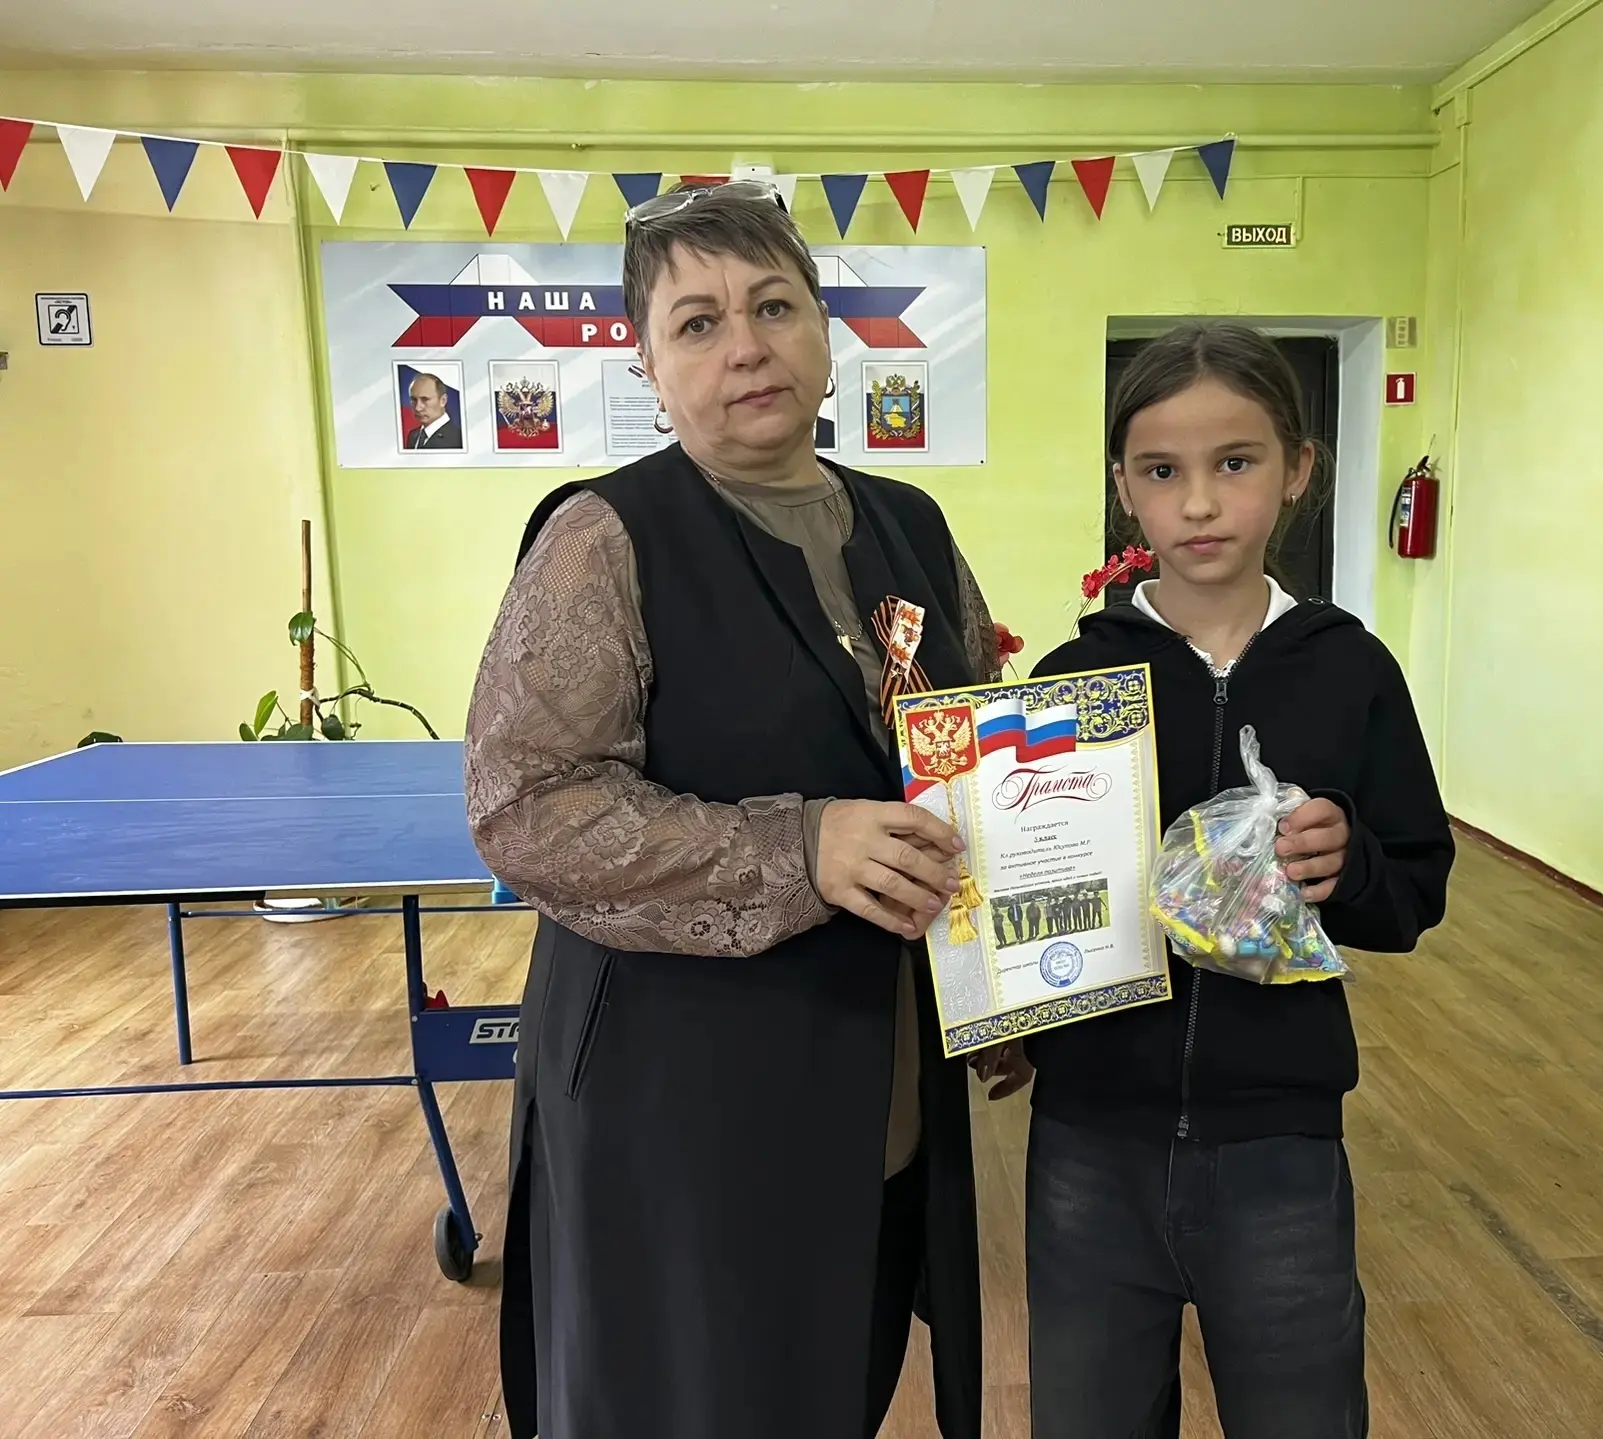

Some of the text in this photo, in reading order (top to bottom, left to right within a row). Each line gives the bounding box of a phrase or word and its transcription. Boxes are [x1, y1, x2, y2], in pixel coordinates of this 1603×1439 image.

[1231, 227, 1287, 244] ВЫХОД
[487, 291, 596, 311] НАША
[581, 322, 628, 343] РО
[992, 764, 1112, 824] Грамота
[1020, 820, 1069, 833] Награждается
[1039, 834, 1057, 842] класс
[1007, 860, 1037, 870] активное
[1037, 856, 1062, 865] участие
[1067, 851, 1093, 860] конкурсе
